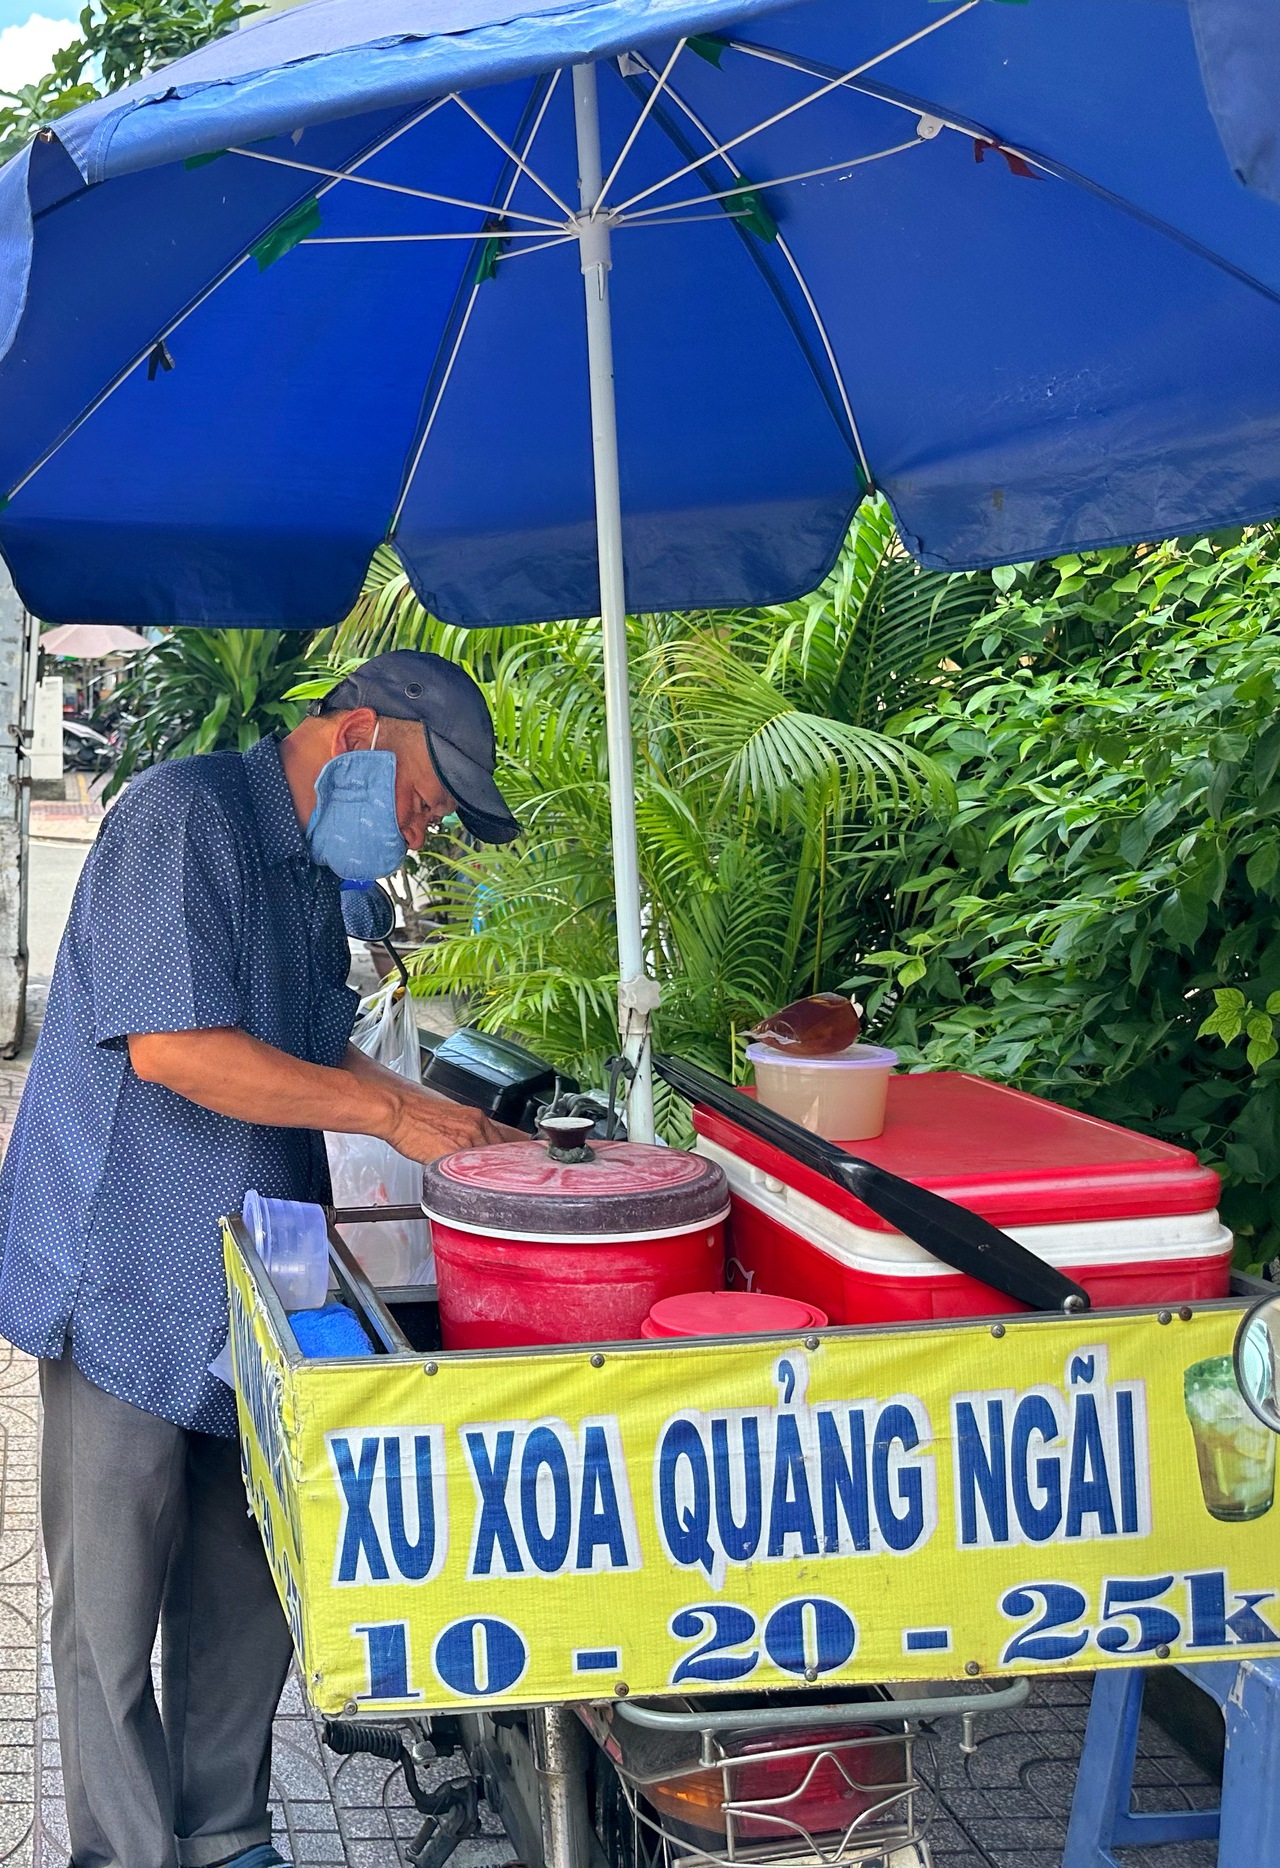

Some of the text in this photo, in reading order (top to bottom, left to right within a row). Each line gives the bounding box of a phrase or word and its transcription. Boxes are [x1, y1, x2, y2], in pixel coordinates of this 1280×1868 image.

[329, 1353, 1139, 1582] XU XOA QUẢNG NGÃI
[354, 1617, 526, 1700] 10
[671, 1598, 856, 1684] 20
[1001, 1571, 1280, 1664] 25k
